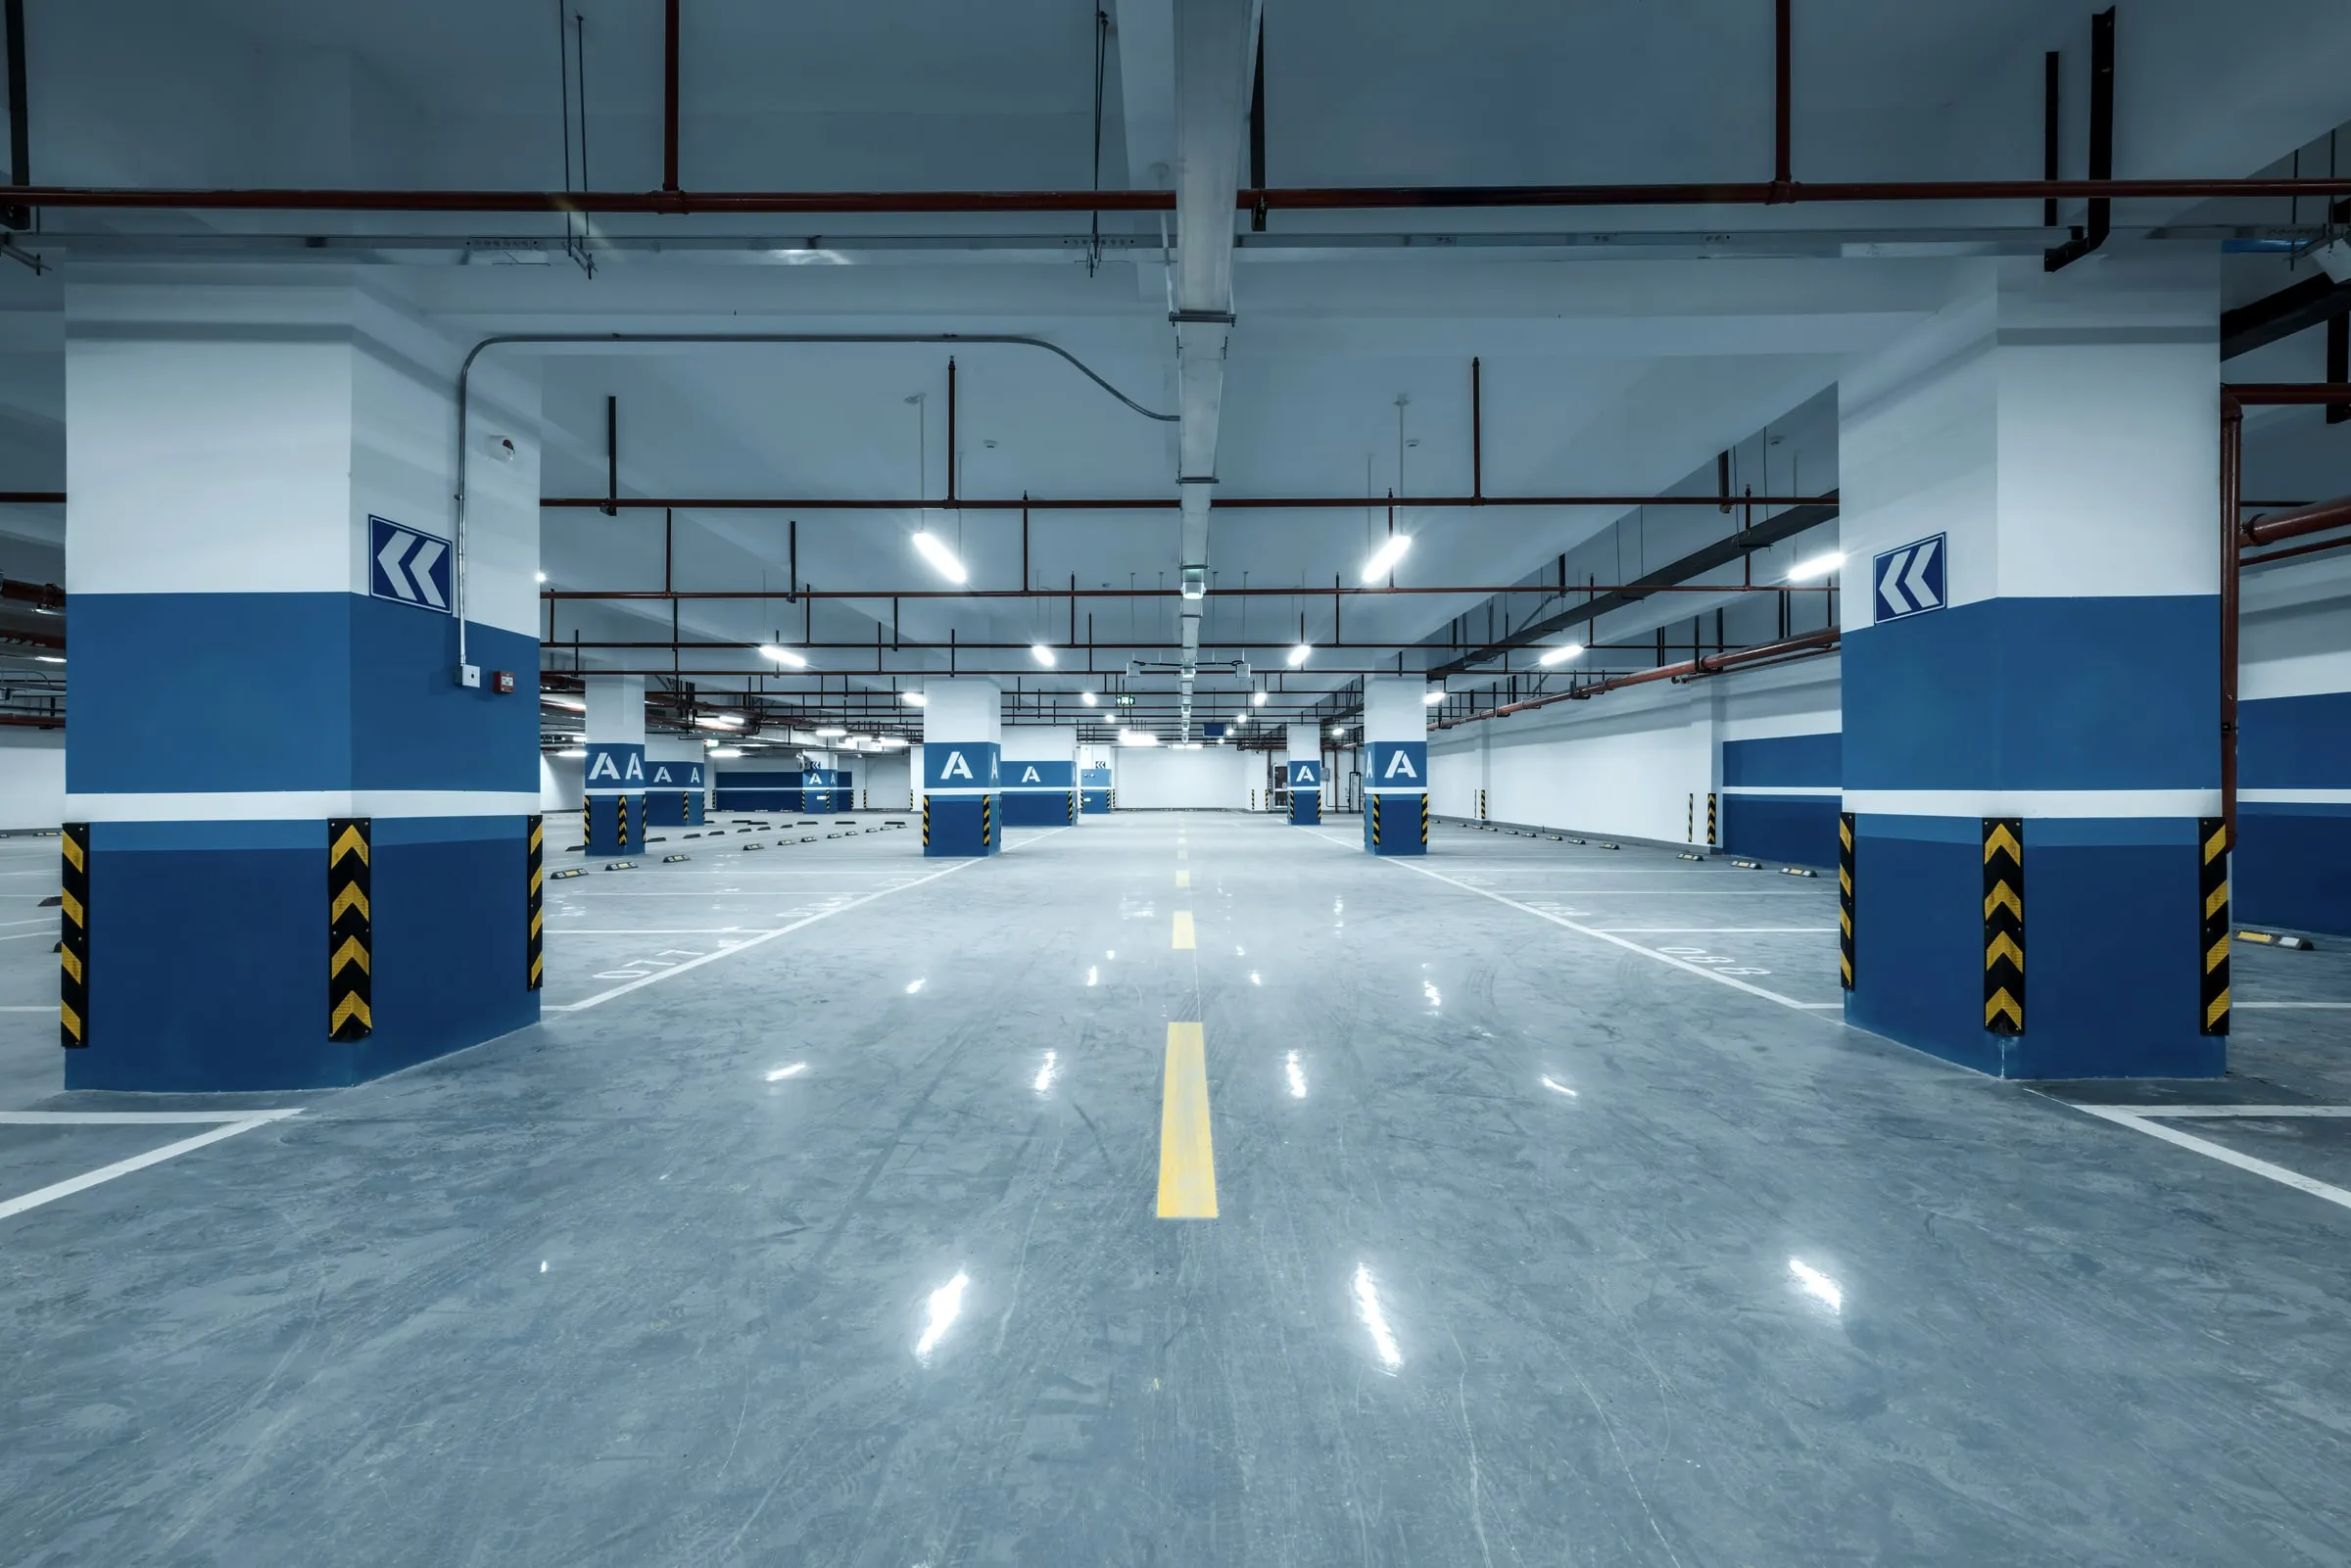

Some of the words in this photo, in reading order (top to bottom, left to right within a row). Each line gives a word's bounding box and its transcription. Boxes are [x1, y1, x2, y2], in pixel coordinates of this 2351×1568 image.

[589, 752, 621, 781] A
[625, 752, 644, 781] A
[653, 766, 672, 784] A
[691, 767, 699, 784] A
[809, 773, 823, 784] A
[939, 751, 974, 780] A
[991, 751, 998, 780] A
[1021, 766, 1041, 784] A
[1296, 765, 1316, 783] A
[1366, 750, 1373, 779] A
[1384, 750, 1417, 779] A
[1655, 946, 1772, 975] 088
